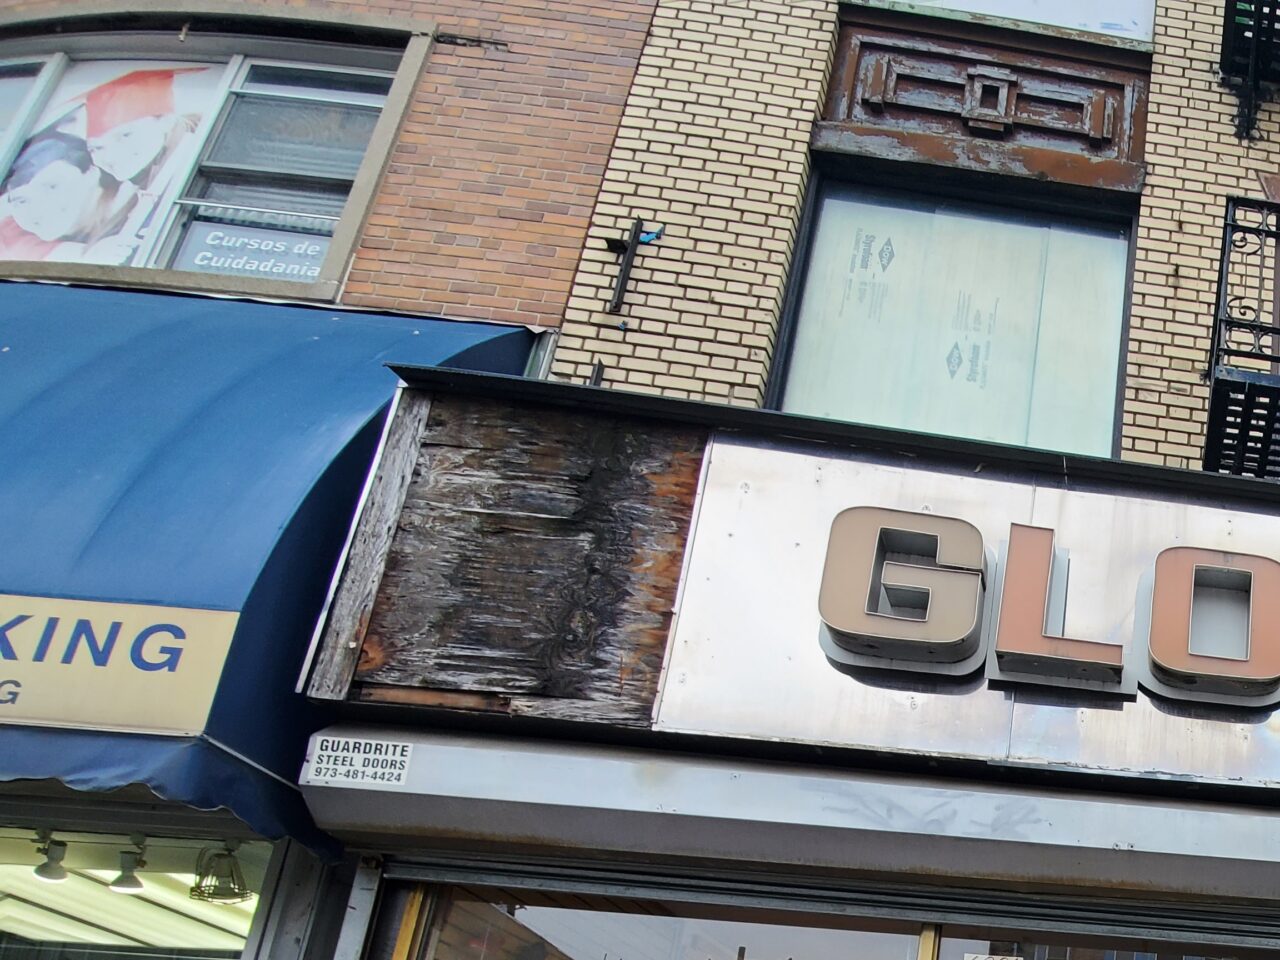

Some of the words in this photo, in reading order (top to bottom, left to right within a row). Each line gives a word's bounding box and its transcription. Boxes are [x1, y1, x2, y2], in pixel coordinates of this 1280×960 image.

[205, 231, 288, 252] Cursos
[293, 240, 320, 255] de
[194, 251, 321, 277] Cuidadania
[320, 739, 409, 757] GUARDRITE
[316, 754, 356, 767] STEEL
[362, 757, 406, 771] DOORS
[314, 767, 402, 782] 973-481-4424
